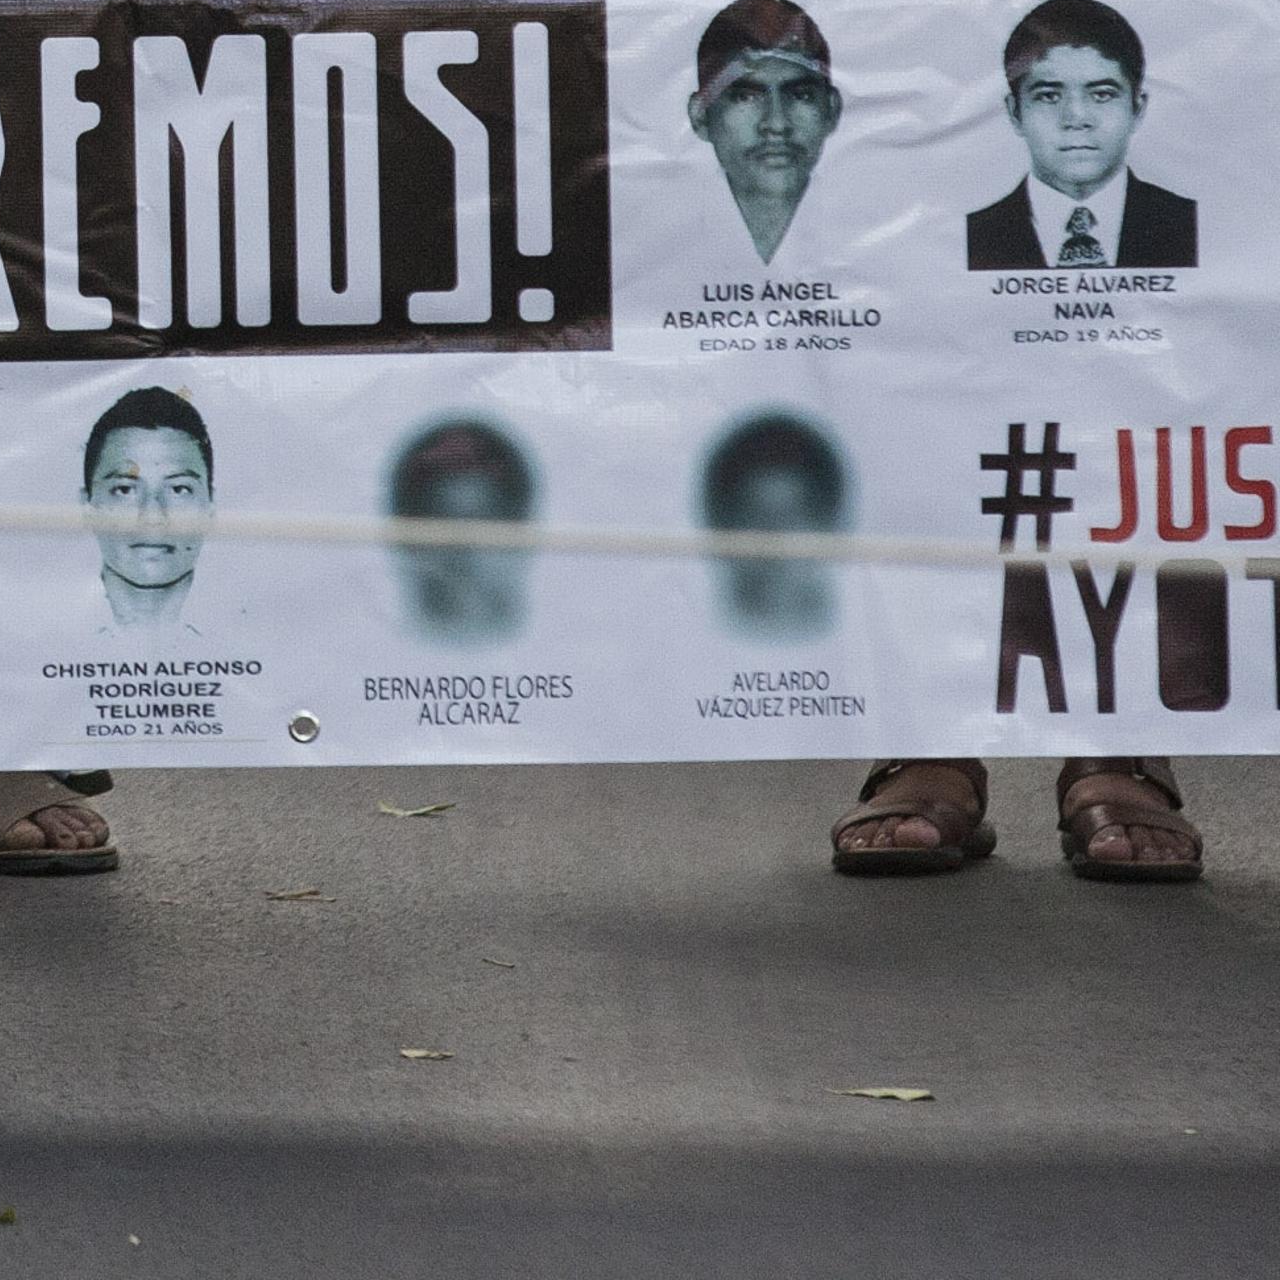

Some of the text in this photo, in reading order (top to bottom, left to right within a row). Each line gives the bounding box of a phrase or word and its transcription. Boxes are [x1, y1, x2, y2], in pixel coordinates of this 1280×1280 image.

[703, 280, 839, 303] LUIS ÁNGEL
[992, 273, 1176, 296] JORGE ÁLVAREZ
[663, 309, 881, 329] ABARCA CARRILLO
[1055, 303, 1116, 320] NAVA
[43, 661, 263, 679] CHISTIAN ALFONSO
[89, 680, 222, 699] RODRÍGUEZ
[365, 675, 574, 702] BERNARDO FLORES
[733, 671, 830, 693] AVELARDO
[96, 704, 216, 719] TELUMBRE
[419, 701, 520, 726] ALCARAZ
[697, 696, 865, 720] VÁZQUEZ PENITEN
